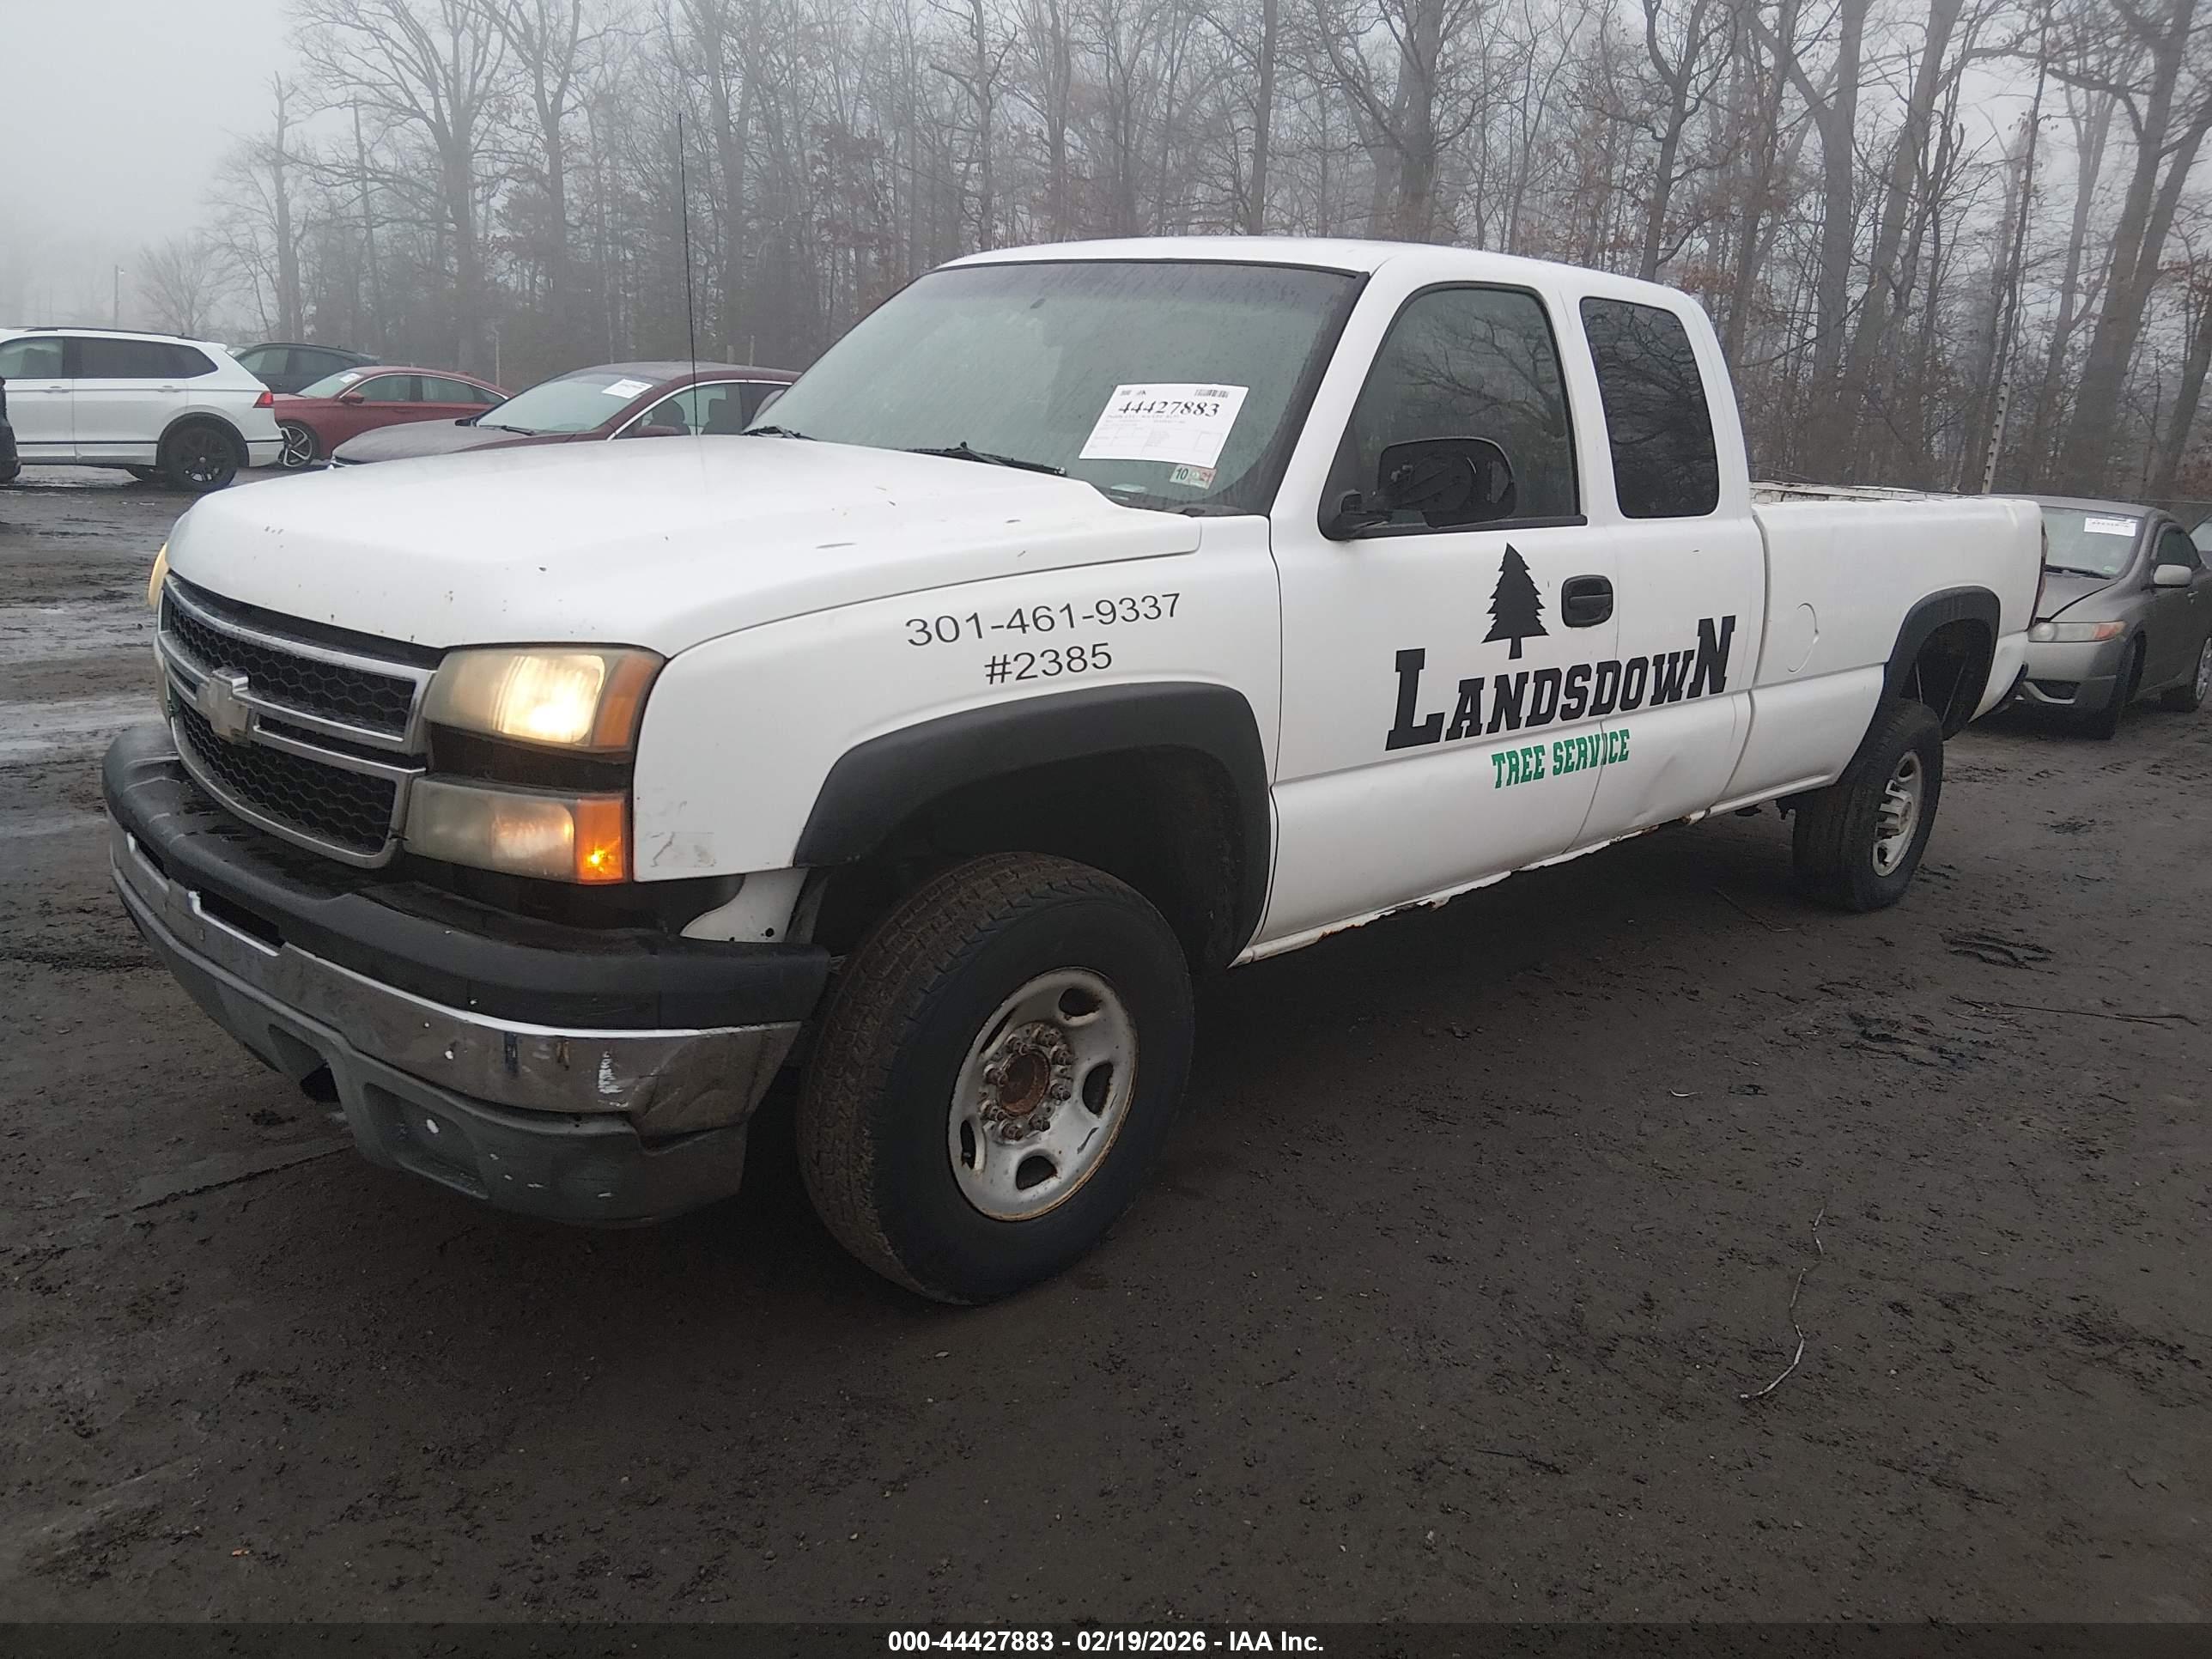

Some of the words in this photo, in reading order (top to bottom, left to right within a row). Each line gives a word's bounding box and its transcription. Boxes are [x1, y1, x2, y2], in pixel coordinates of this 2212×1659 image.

[1118, 400, 1220, 417] 44427883
[1175, 467, 1188, 480] 10
[905, 592, 1181, 647] 301-461-9337
[984, 642, 1113, 685] #2385
[1384, 615, 1736, 751] LANDSDOWN
[1492, 744, 1545, 789] TREE
[1553, 729, 1631, 776] SERVICE
